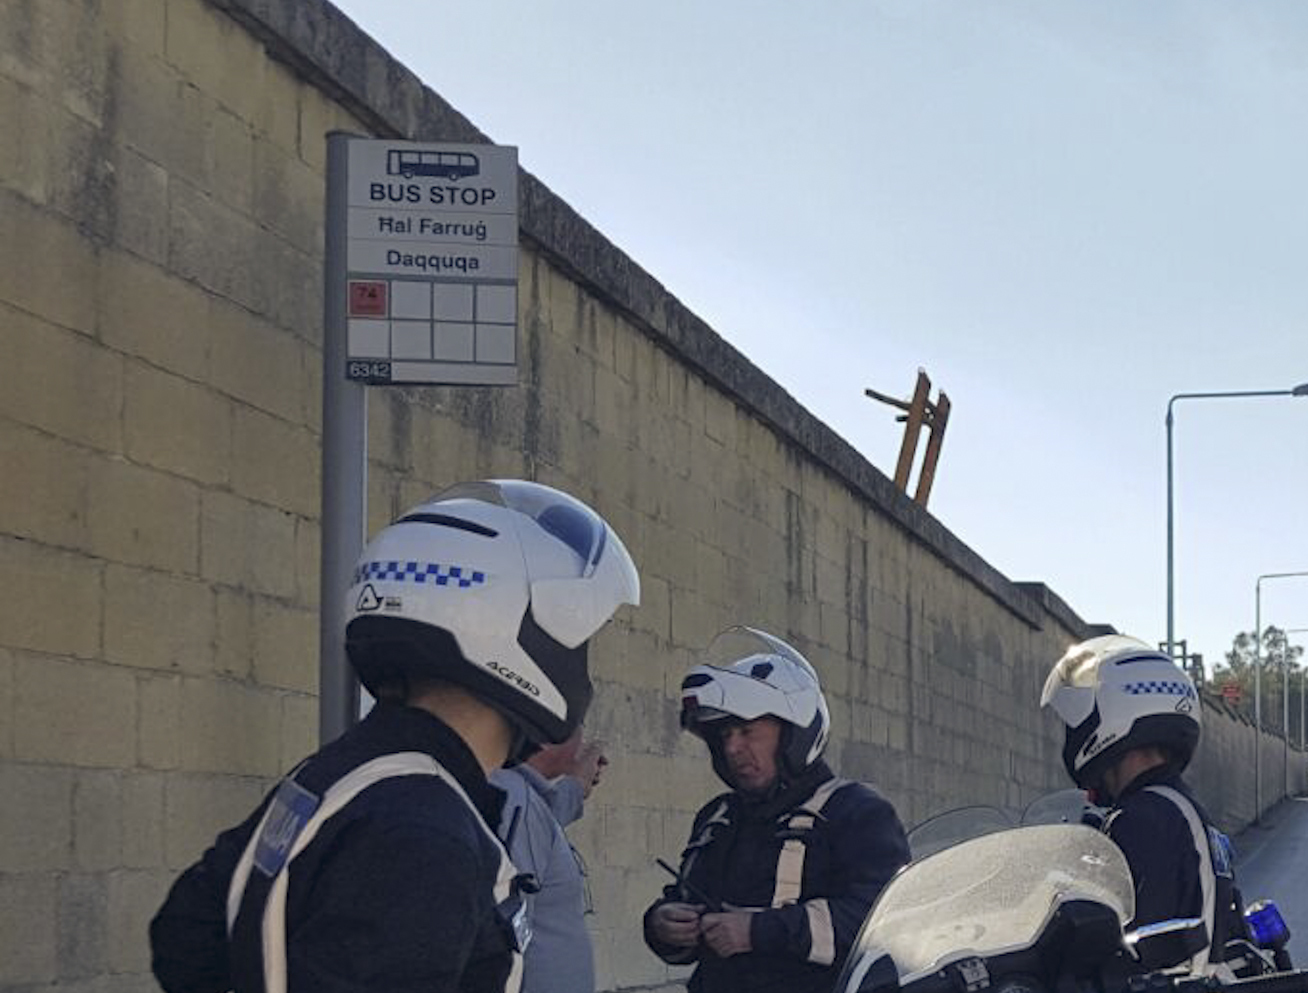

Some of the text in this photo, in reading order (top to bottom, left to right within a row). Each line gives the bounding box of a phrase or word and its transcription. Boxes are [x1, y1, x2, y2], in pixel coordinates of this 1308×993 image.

[369, 183, 496, 206] BUS STOP
[420, 218, 487, 241] Farruġ
[386, 250, 480, 273] Daqquqa
